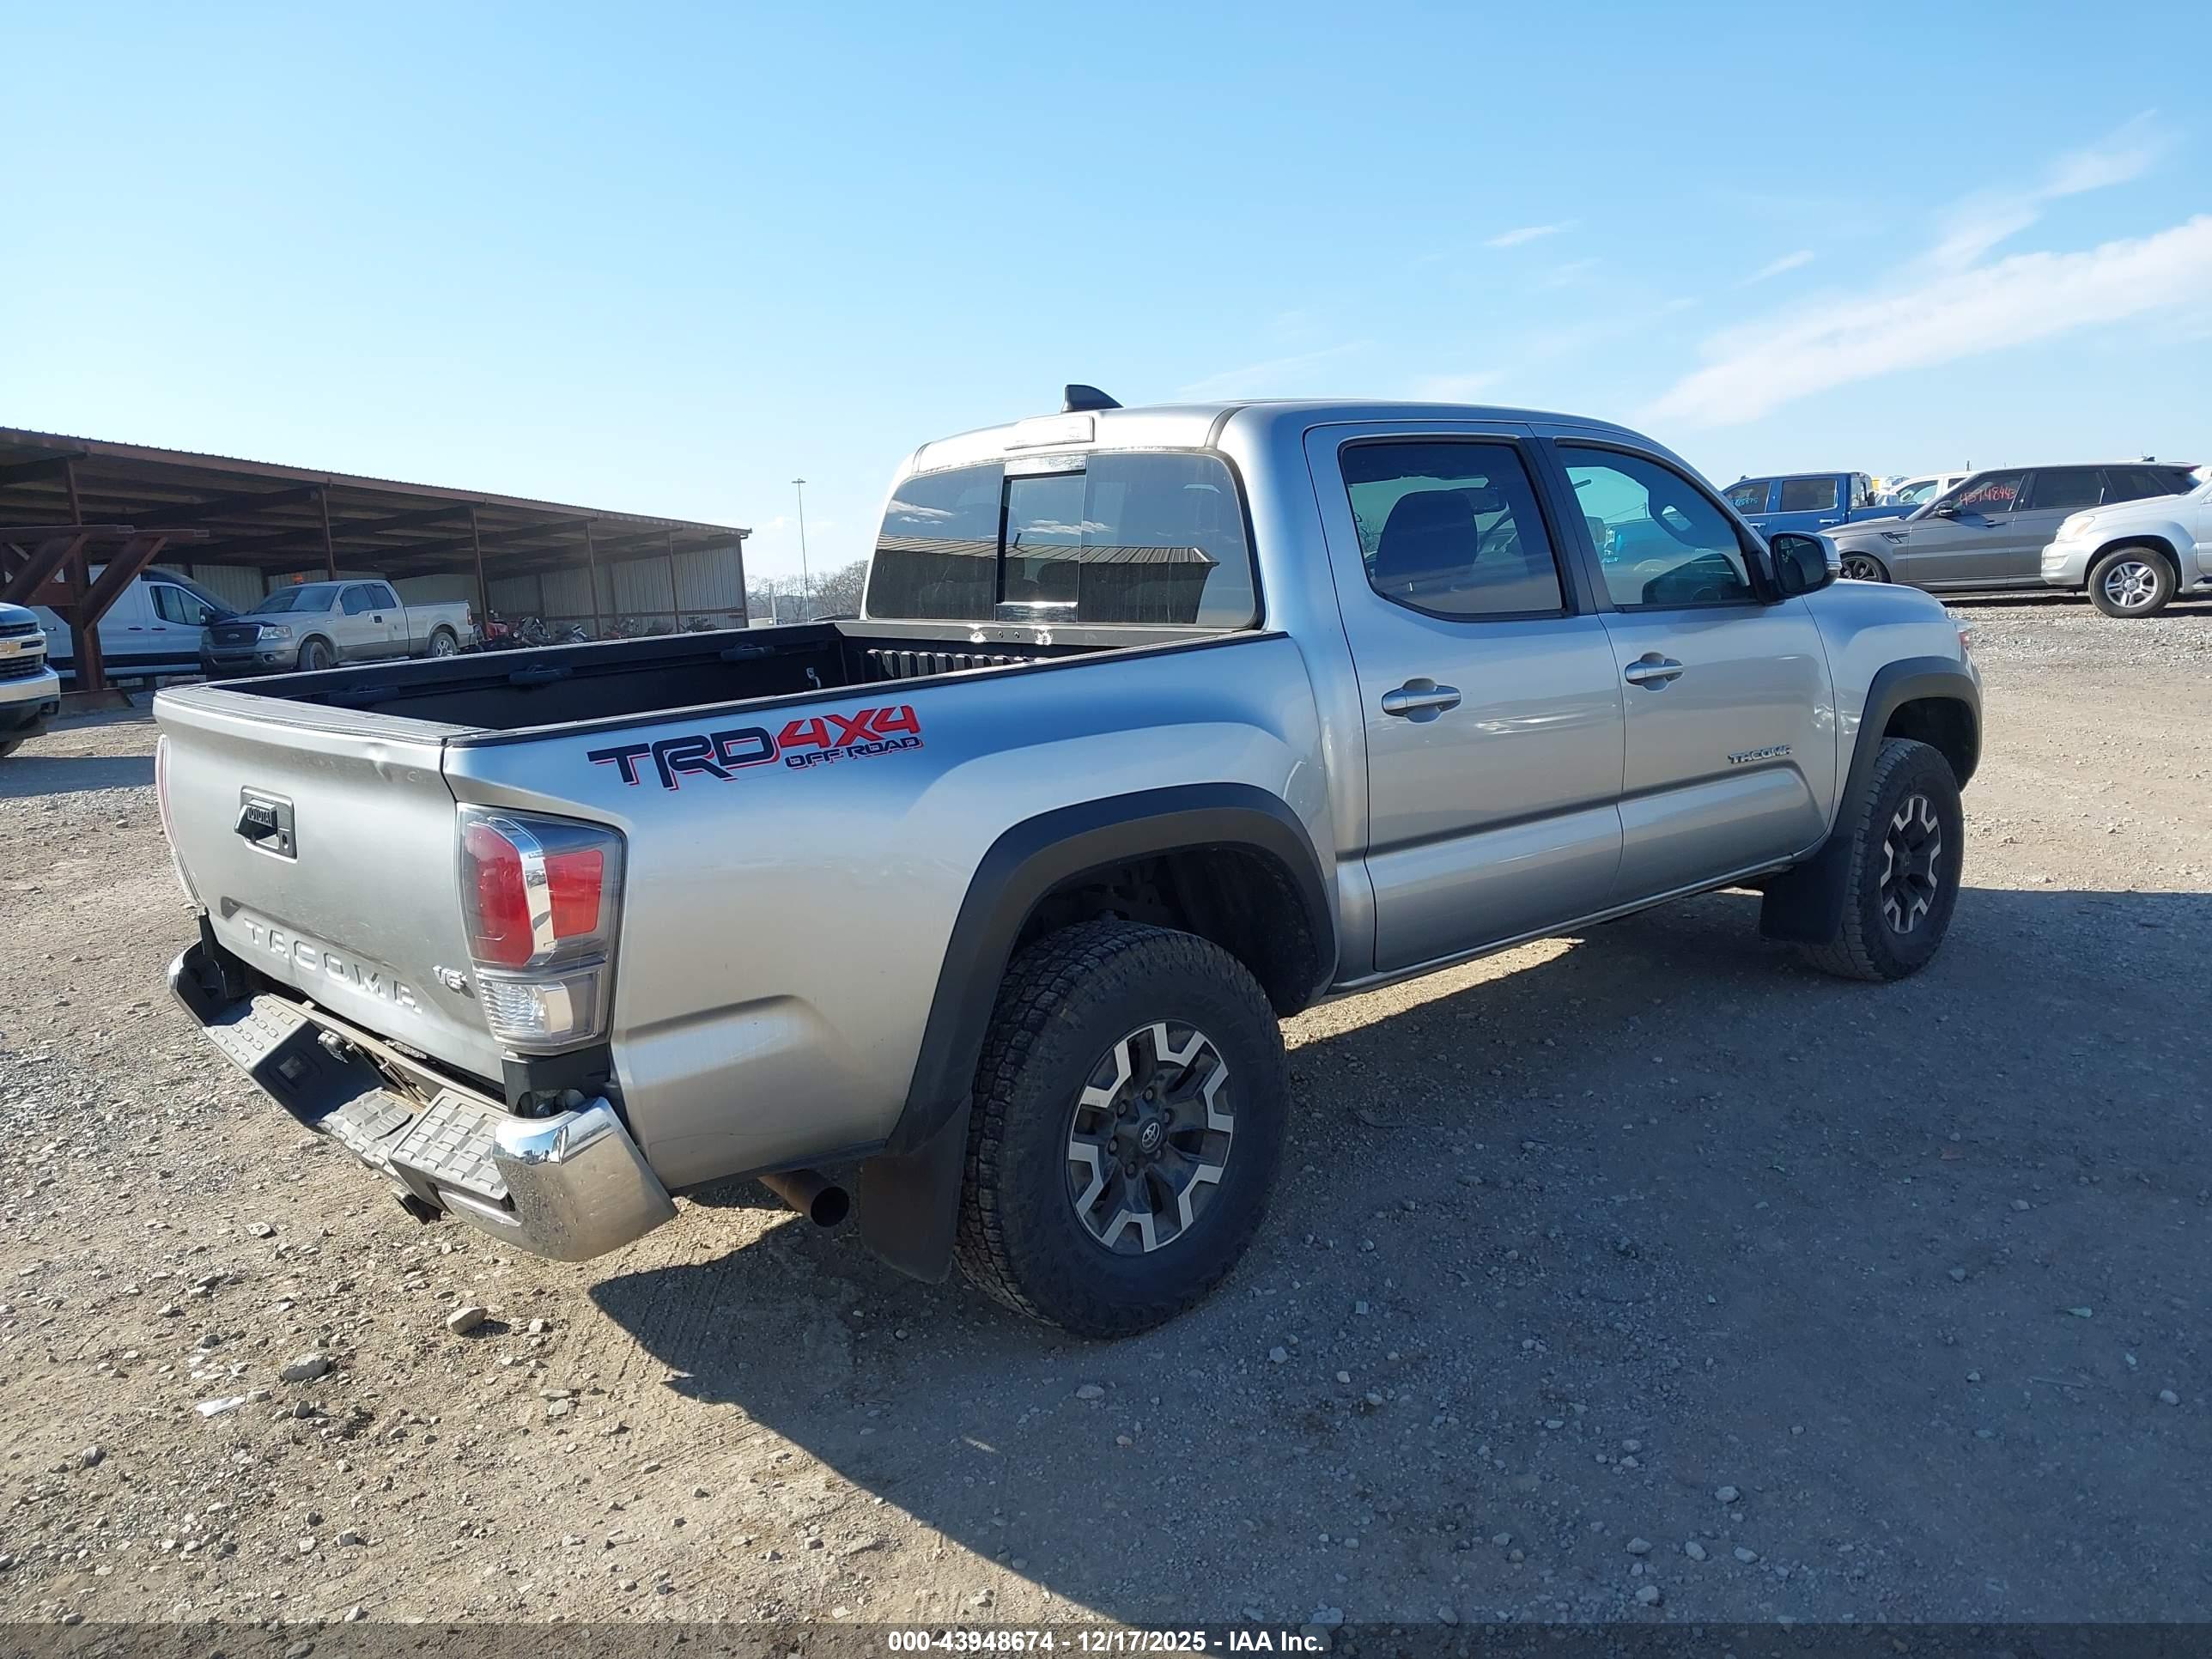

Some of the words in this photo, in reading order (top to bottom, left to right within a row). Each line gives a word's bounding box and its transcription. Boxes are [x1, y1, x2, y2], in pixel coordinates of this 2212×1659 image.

[587, 726, 781, 791] TRD
[779, 705, 921, 750] 4X4
[785, 750, 844, 769] OFF
[847, 736, 924, 758] ROAD
[1728, 744, 1792, 764] TACOMA
[246, 806, 273, 828] TOYOTA
[244, 918, 423, 1014] TACOMA
[432, 964, 467, 990] V6
